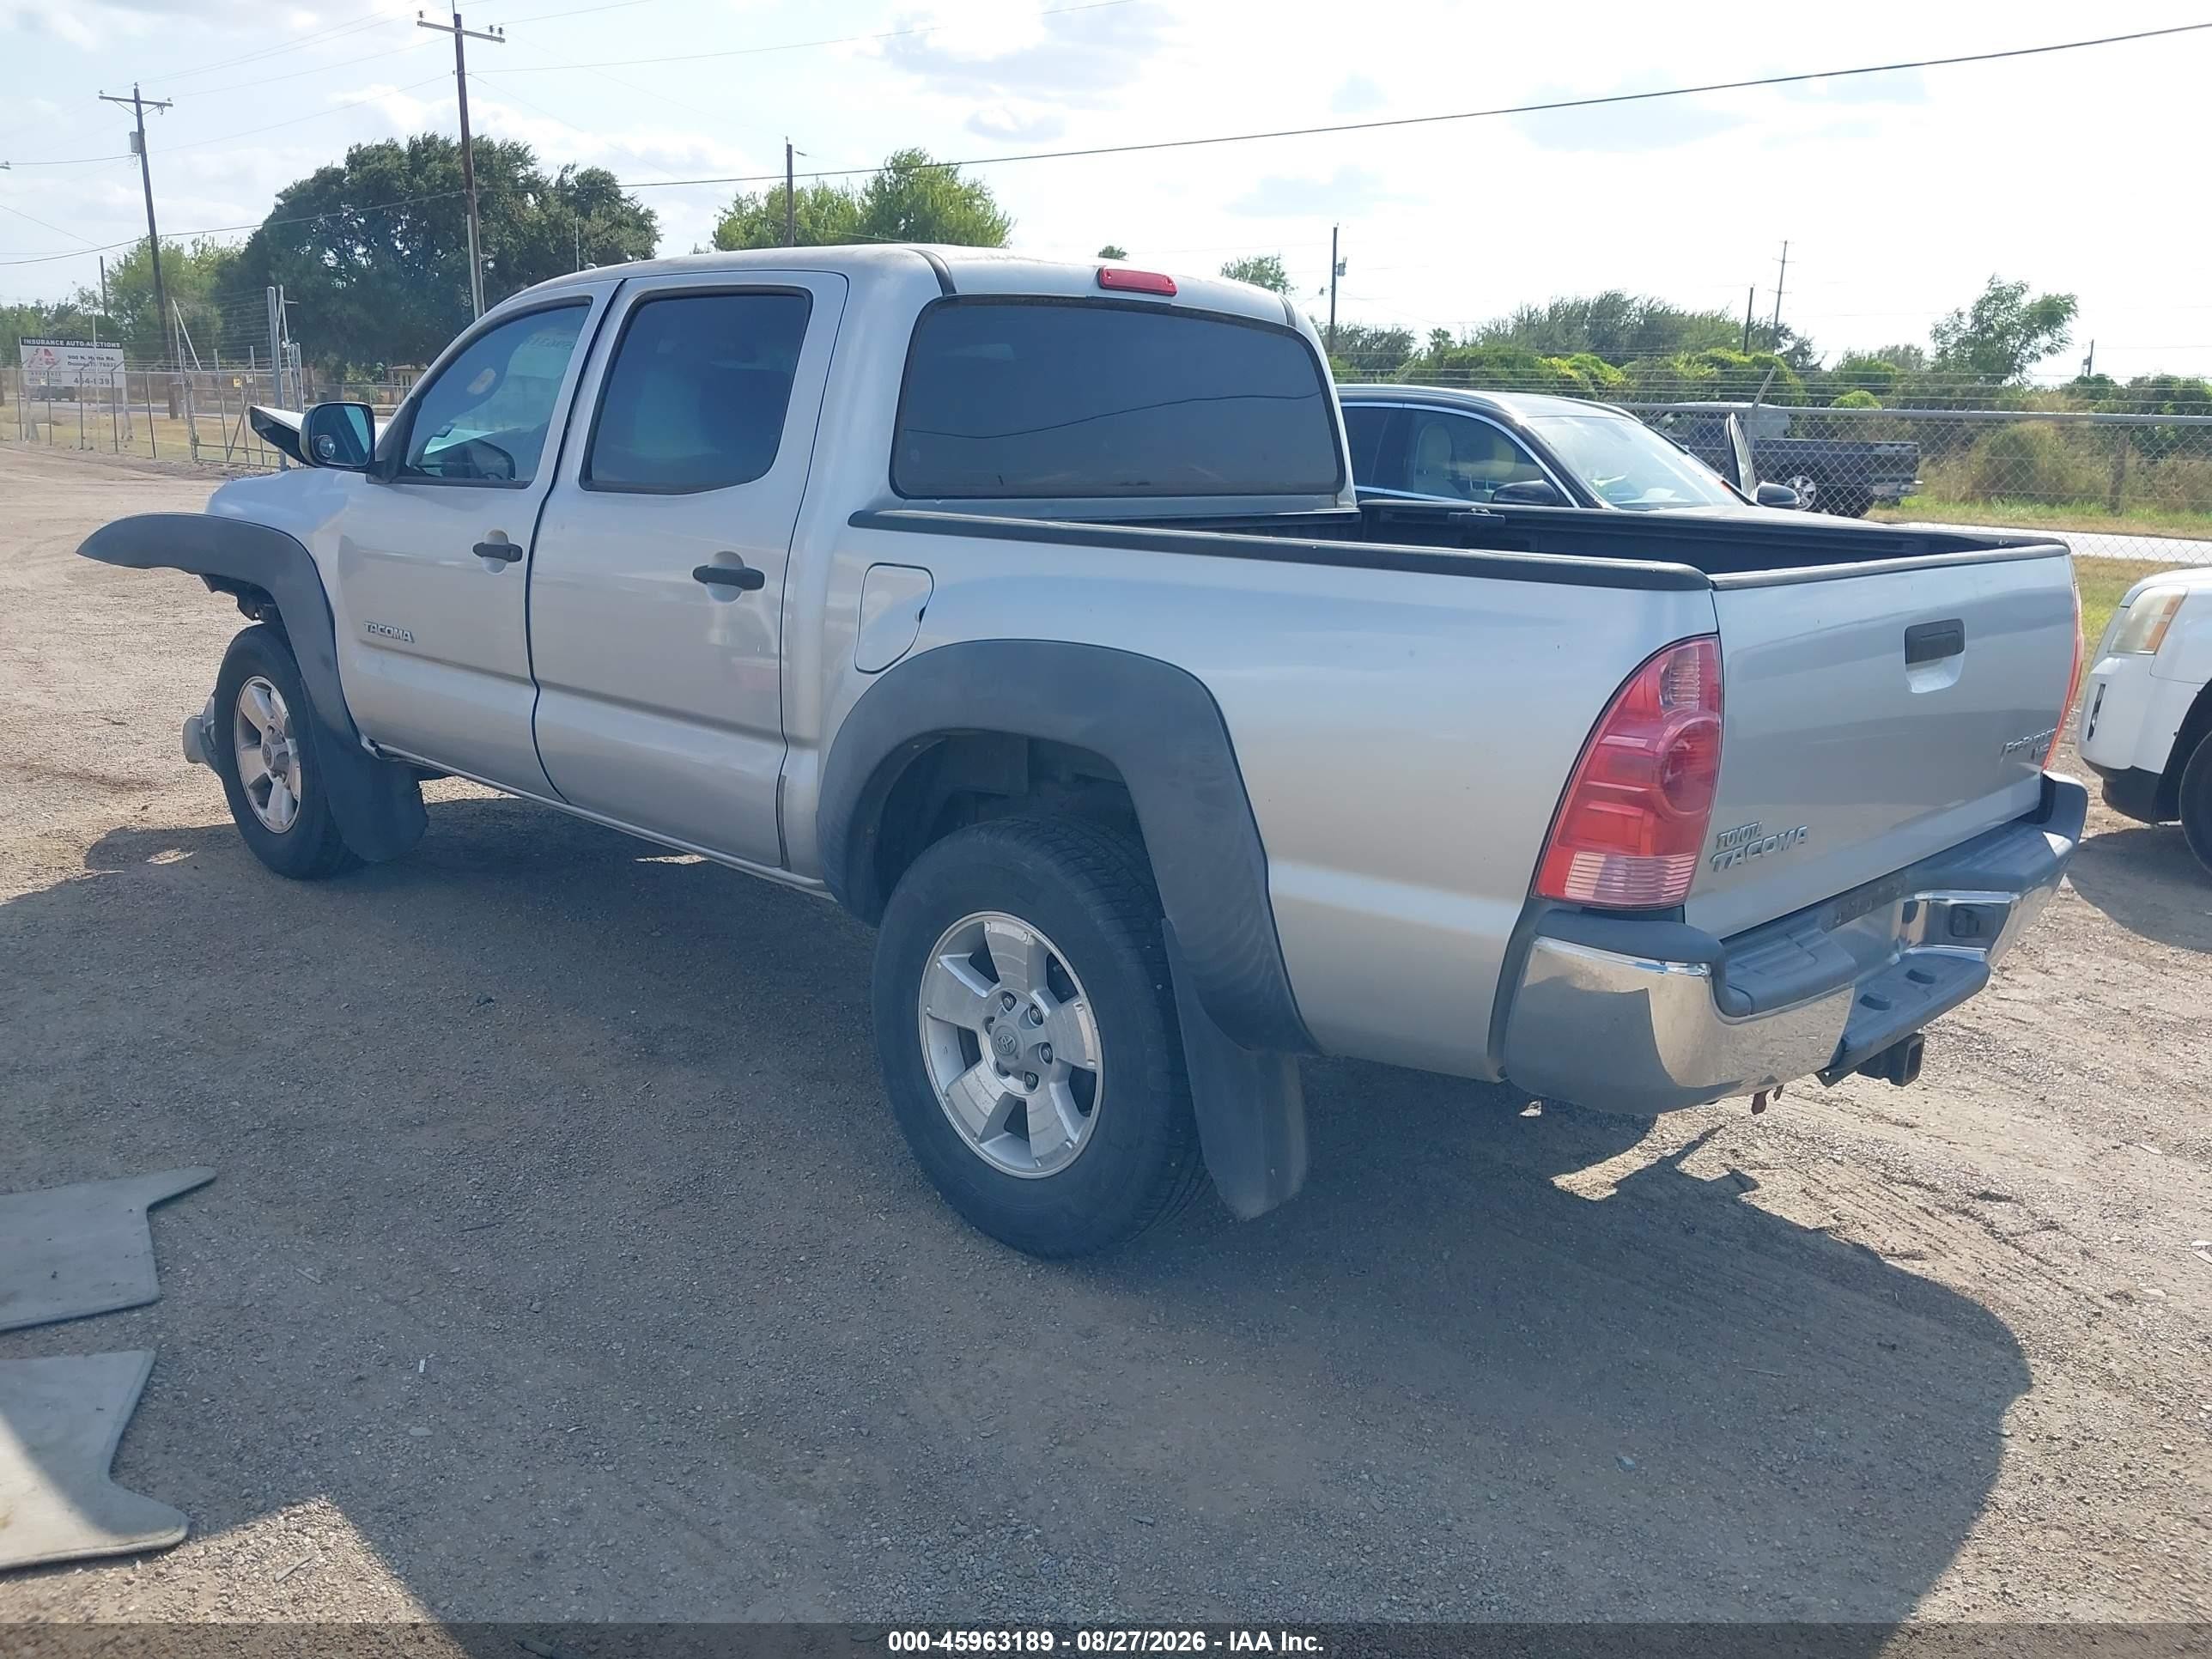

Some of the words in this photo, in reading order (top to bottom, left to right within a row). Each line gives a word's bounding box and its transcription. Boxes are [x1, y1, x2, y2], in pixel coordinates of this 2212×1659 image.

[24, 338, 65, 347] INSURANCE
[364, 621, 415, 643] TACOMA
[1710, 825, 1808, 872] TACOMA
